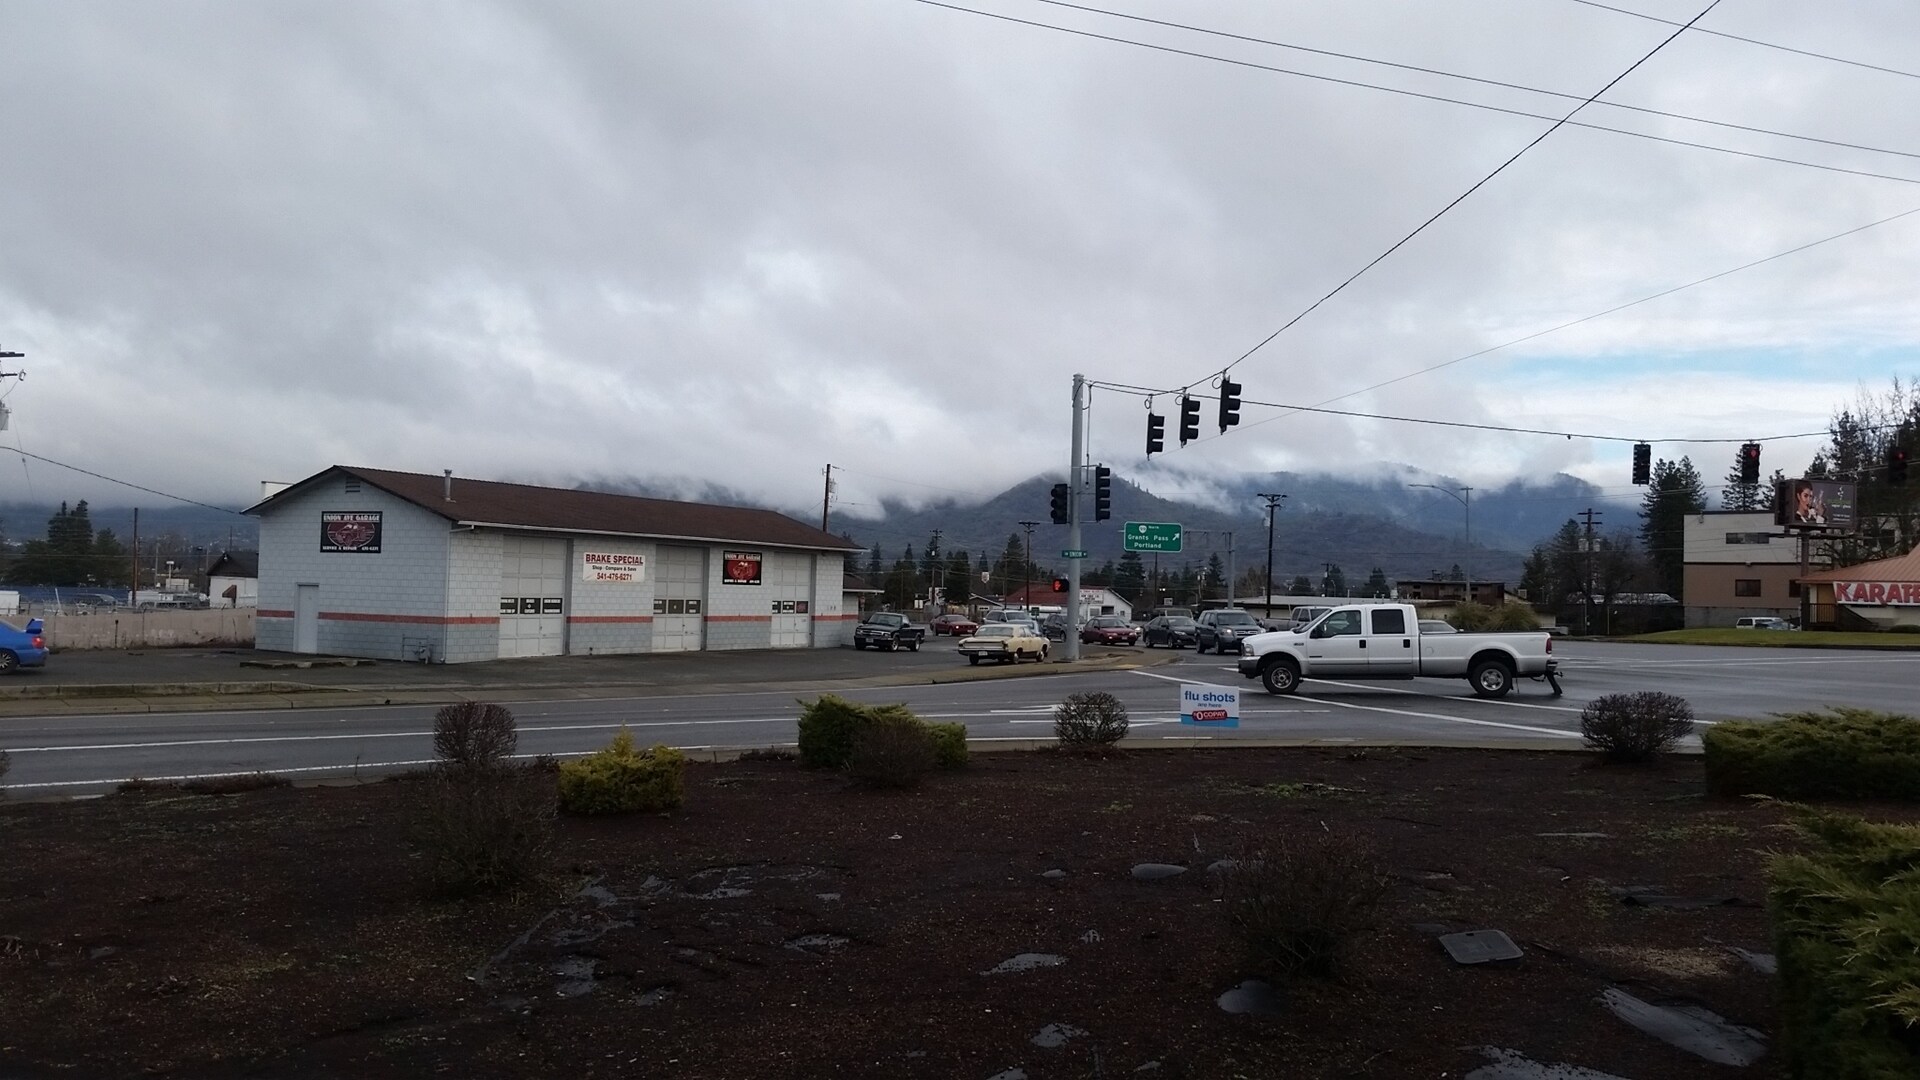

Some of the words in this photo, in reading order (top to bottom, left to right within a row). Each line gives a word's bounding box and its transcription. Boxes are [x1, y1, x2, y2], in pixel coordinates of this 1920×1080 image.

[585, 554, 611, 563] BRAKE
[613, 555, 644, 564] SPECIAL
[596, 572, 633, 581] 541-476-6271
[1835, 582, 1920, 607] KARATE
[1184, 690, 1199, 701] flu
[1202, 692, 1236, 703] shots
